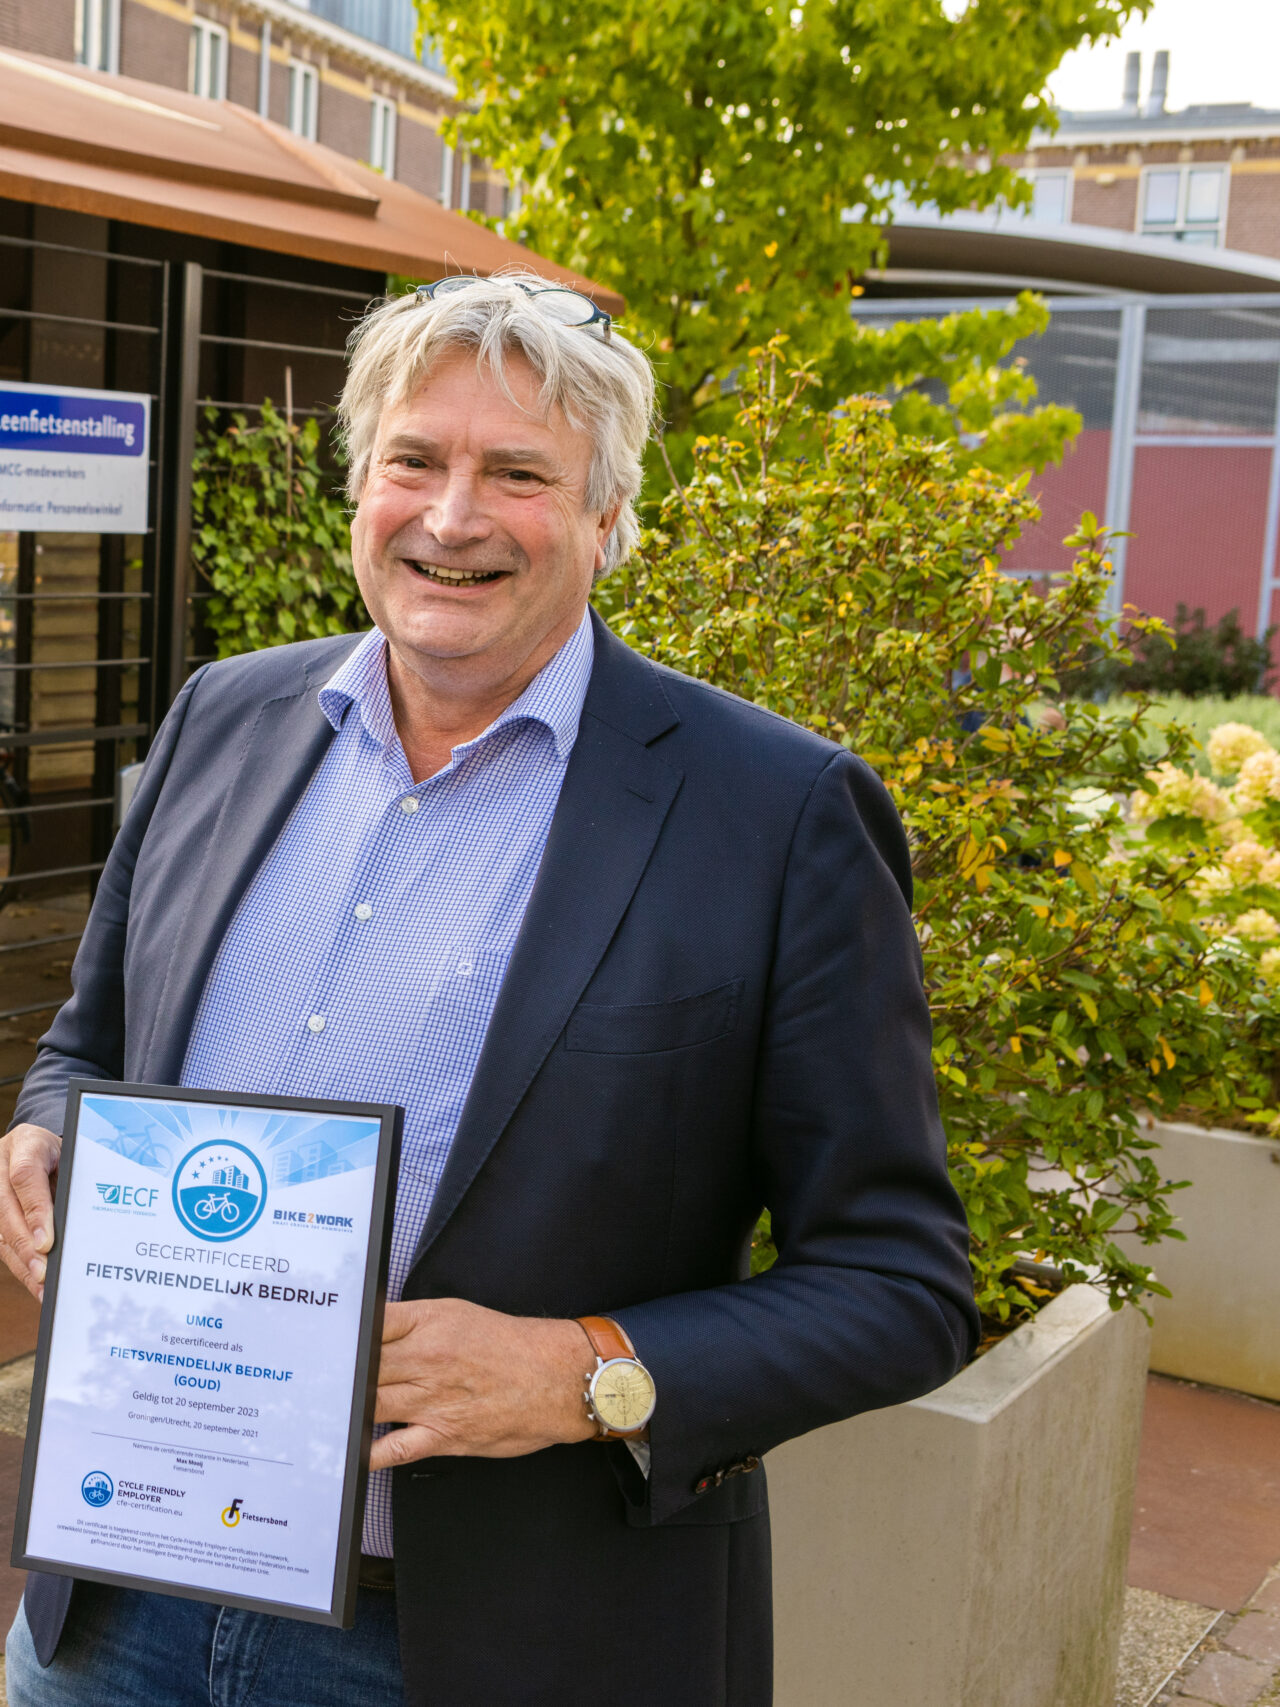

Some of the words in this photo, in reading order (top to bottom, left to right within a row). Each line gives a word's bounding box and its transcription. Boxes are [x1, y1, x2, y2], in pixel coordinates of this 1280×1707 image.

[47, 501, 123, 516] Personeelswinkel
[122, 1186, 159, 1207] ECF
[273, 1209, 353, 1228] BIKE2WORK
[135, 1241, 290, 1274] GECERTIFICEERD
[86, 1262, 253, 1298] FIETSVRIENDELIJK
[258, 1282, 338, 1307] BEDRIJF
[186, 1314, 223, 1329] UMCG
[161, 1333, 168, 1342] is
[170, 1336, 228, 1351] gecertificeerd
[231, 1342, 243, 1353] als
[110, 1346, 232, 1374] FIETSVRIENDELIJK
[235, 1364, 294, 1382] BEDRIJF
[174, 1374, 221, 1392] (GOUD)
[132, 1390, 159, 1405] Geldig
[161, 1395, 173, 1405] tot
[175, 1397, 186, 1407] 20
[188, 1400, 235, 1414] september
[237, 1406, 259, 1418] 2023
[128, 1411, 192, 1429] Groningen/Utrecht,
[193, 1421, 202, 1430] 20
[203, 1423, 240, 1436] september
[242, 1429, 259, 1438] 2021
[173, 1465, 205, 1475] Fietsersbond
[117, 1489, 161, 1503] EMPLOYER
[118, 1480, 144, 1491] CYCLE
[146, 1484, 186, 1498] FRIENDLY
[116, 1500, 183, 1517] cfe-certification.eu
[242, 1512, 288, 1527] Fietsersbond
[228, 1546, 259, 1557] Certification
